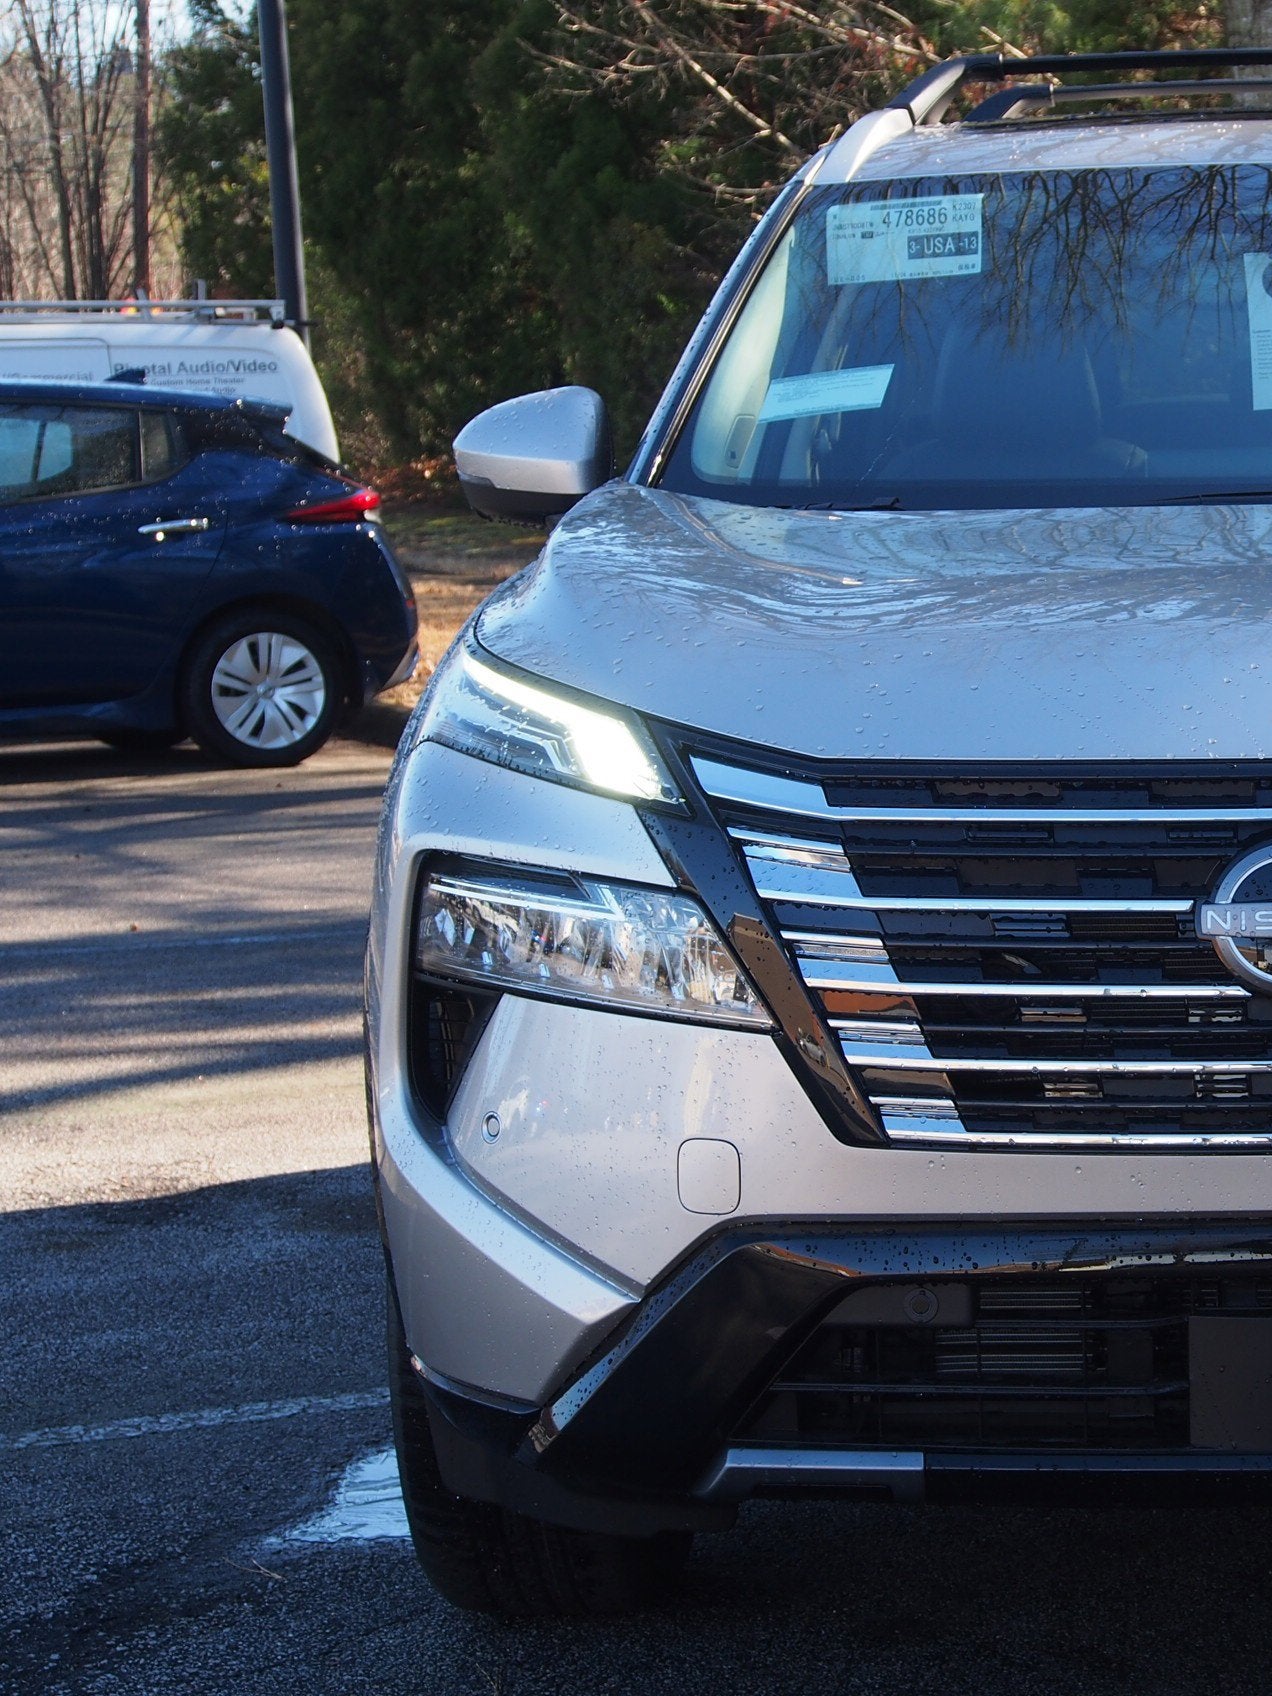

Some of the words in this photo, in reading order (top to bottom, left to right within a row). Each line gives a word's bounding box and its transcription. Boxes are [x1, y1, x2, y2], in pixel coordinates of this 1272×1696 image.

[882, 207, 948, 228] 478686
[923, 234, 956, 254] USA
[177, 359, 278, 375] Audio/Video
